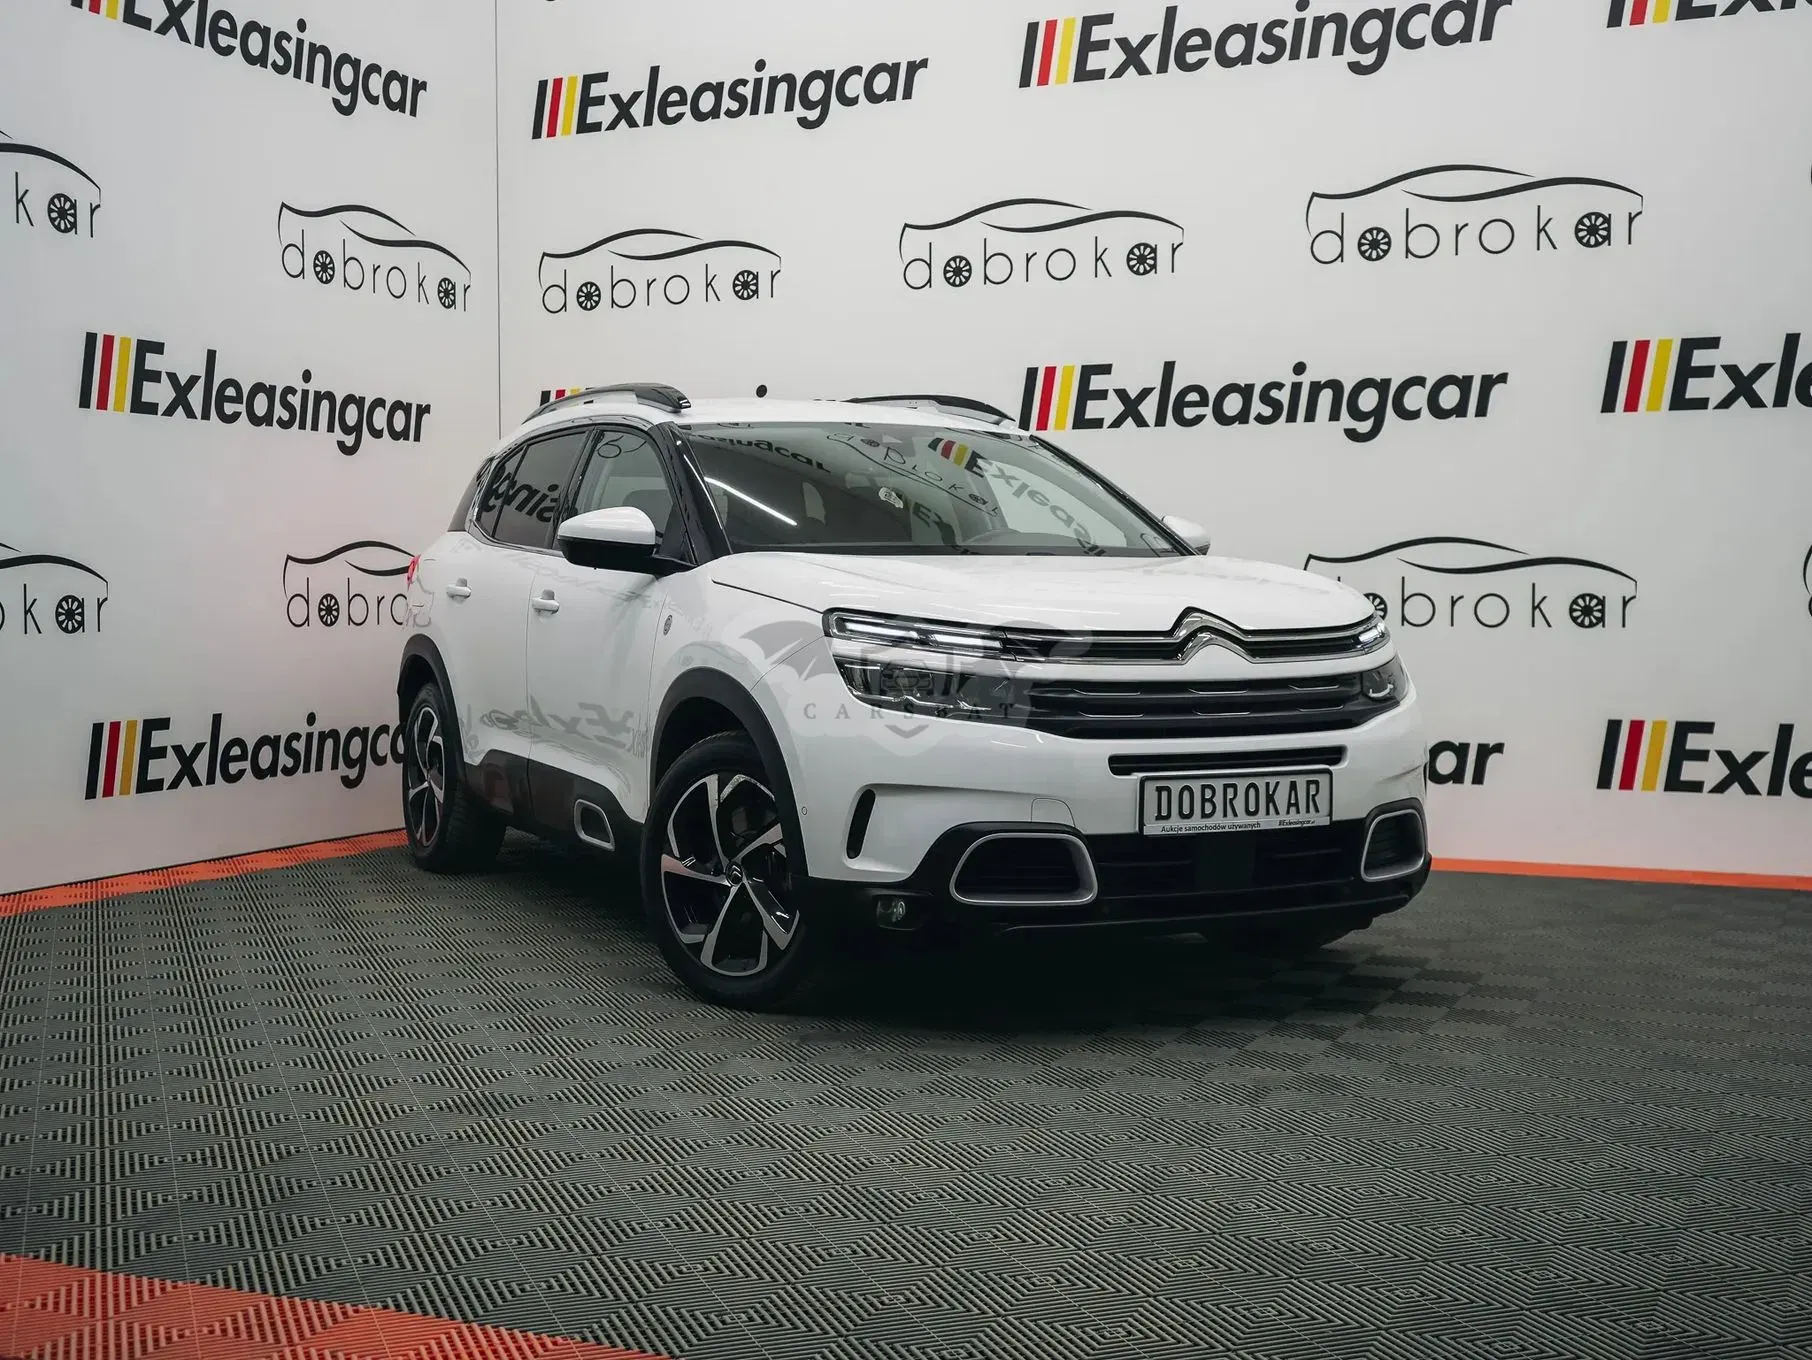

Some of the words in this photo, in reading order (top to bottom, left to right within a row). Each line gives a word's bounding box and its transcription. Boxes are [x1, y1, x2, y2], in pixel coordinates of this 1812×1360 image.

[1073, 0, 1512, 83] Exleasingcar
[575, 58, 929, 133] Exleasingcar
[130, 339, 431, 456] Exleasingcar
[1072, 361, 1508, 443] Exleasingcar
[1155, 779, 1320, 821] DOBROKAR
